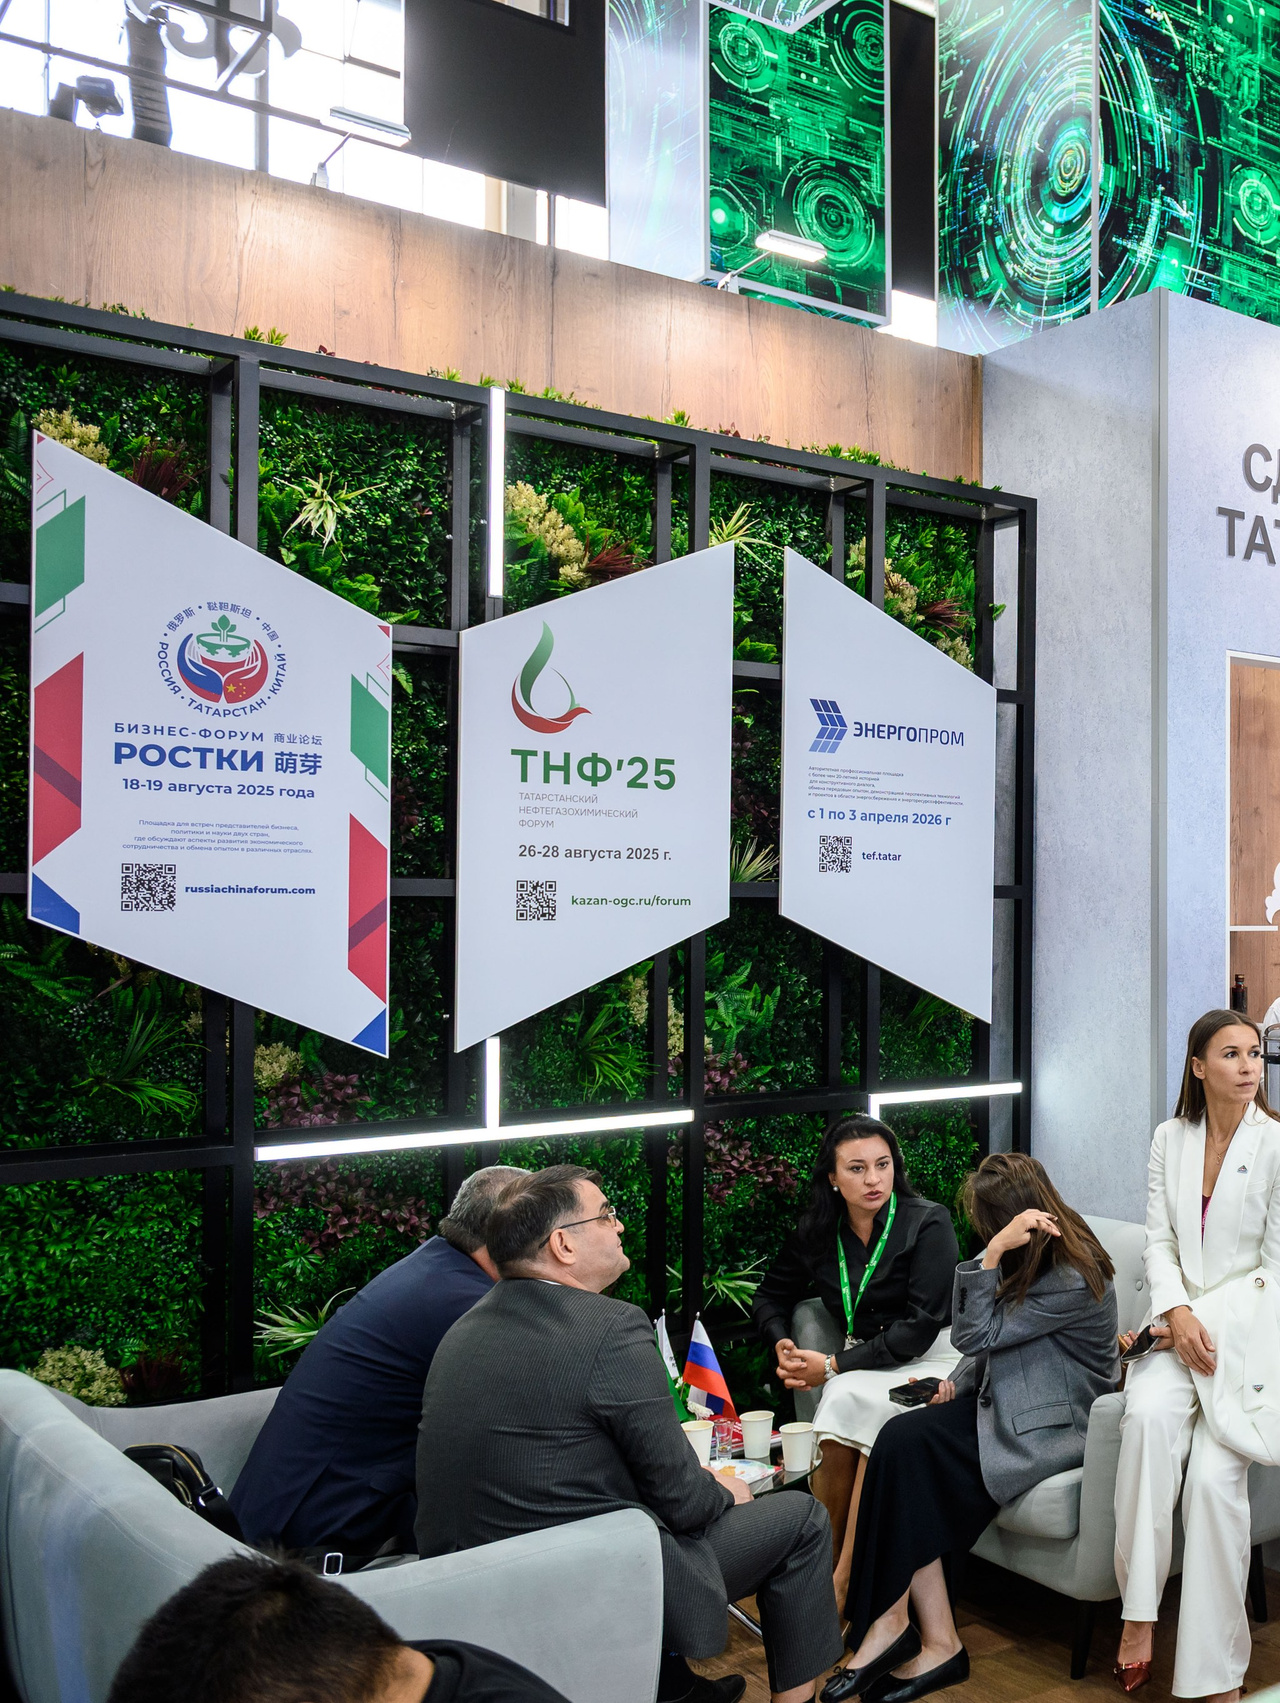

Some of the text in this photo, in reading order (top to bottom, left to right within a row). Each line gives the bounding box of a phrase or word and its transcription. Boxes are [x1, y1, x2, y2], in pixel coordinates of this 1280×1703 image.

[166, 607, 196, 632] 俄罗斯
[262, 622, 279, 642] 中国
[158, 642, 182, 695] РОССИЯ
[269, 653, 286, 695] КИТАЙ
[188, 698, 267, 718] ТАТАРСТАН
[115, 723, 264, 742] БИЗНЕС-ФОРУМ
[274, 733, 323, 746] 商业论坛
[853, 721, 964, 747] ЭНЕРГОПРОМ
[114, 742, 264, 772] РОСТКИ
[275, 752, 323, 775] 萌芽
[122, 778, 315, 799] 18-19 августа 2025 года
[519, 792, 598, 805] ТАТАРСТАНСКИЙ
[519, 806, 638, 819] НЕФТЕГАЗОХИМИЧЕСКИЙ
[808, 808, 952, 826] с 1 по 3 апреля 2026 г
[518, 819, 554, 830] ФОРУМ
[148, 836, 186, 844] обсуждают
[518, 844, 672, 863] 26-28 августа 2025 г.
[861, 850, 902, 863] tef.tatar
[185, 885, 315, 895] russiachinaforum.com
[571, 894, 691, 909] kazan-ogc.ru/forum
